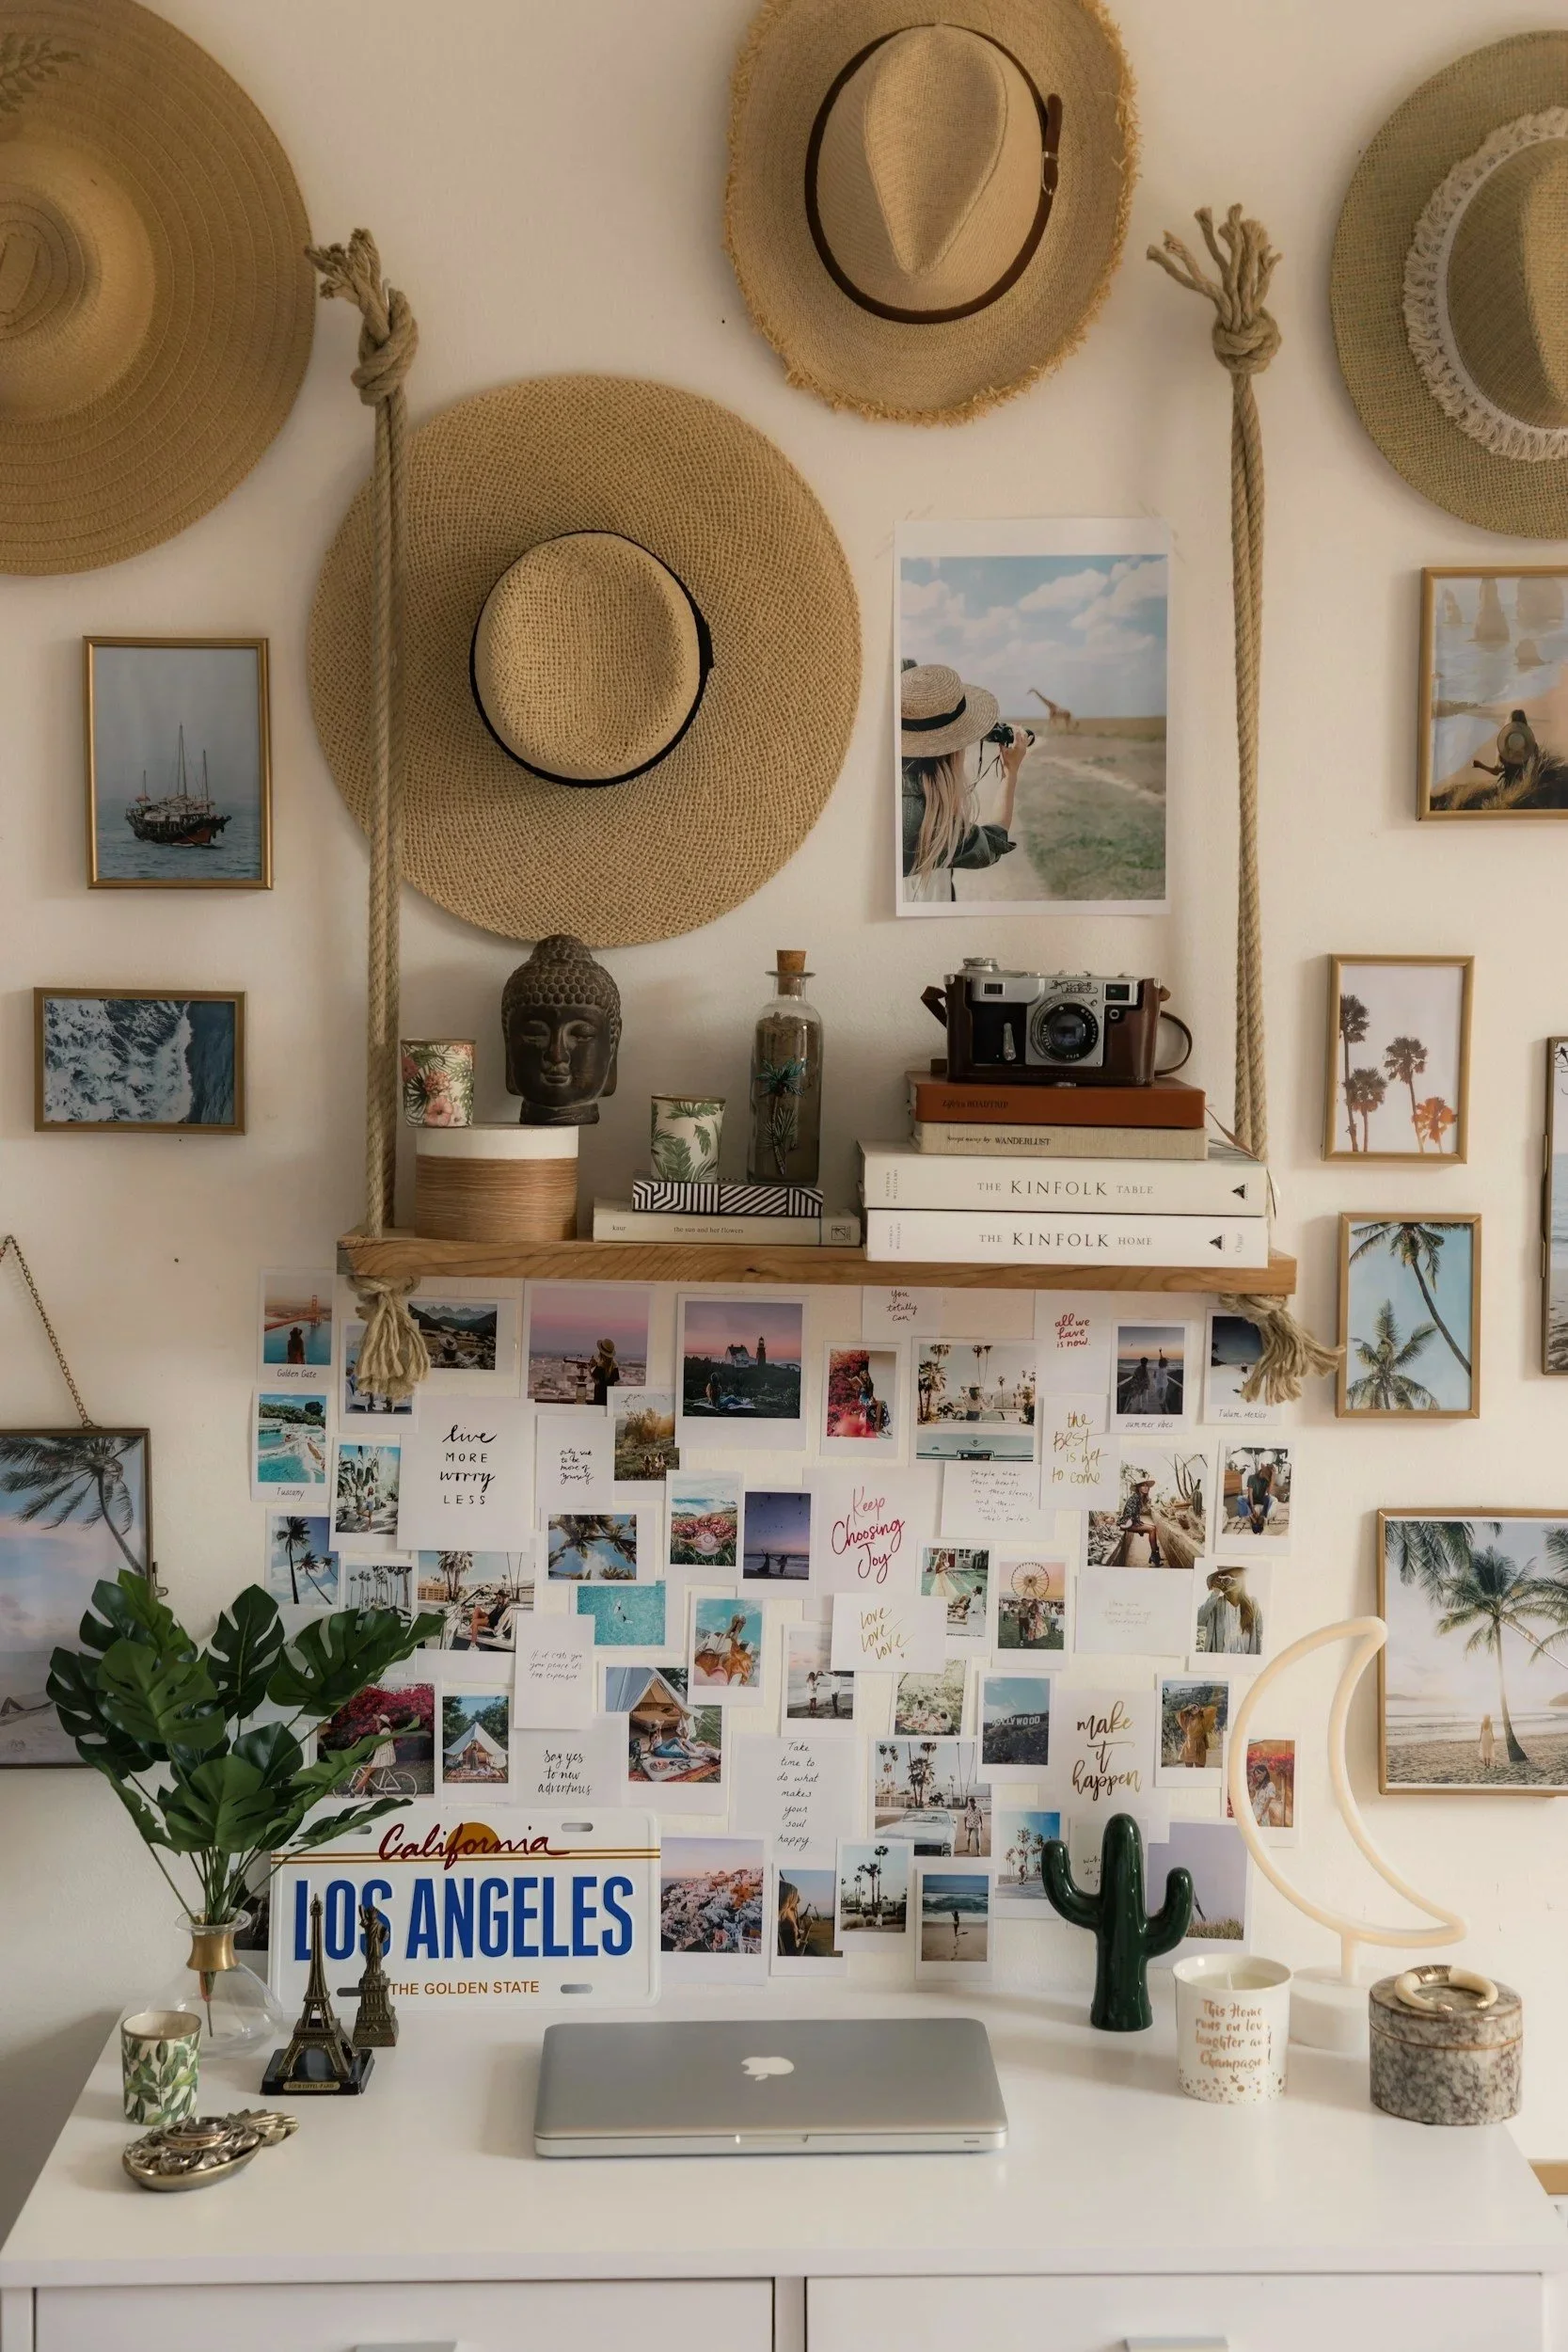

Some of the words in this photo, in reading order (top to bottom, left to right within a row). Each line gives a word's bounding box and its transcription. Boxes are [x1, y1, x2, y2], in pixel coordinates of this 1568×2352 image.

[995, 1136, 1051, 1145] WANDERLUST
[977, 1182, 1002, 1191] THE
[1011, 1181, 1107, 1196] KINFOLK
[1117, 1184, 1153, 1194] TABLE
[979, 1233, 1003, 1243] THE
[1013, 1232, 1109, 1248] KINFOLK
[1118, 1236, 1152, 1246] HOME
[885, 1302, 918, 1315] totally
[1054, 1312, 1074, 1327] all
[1057, 1327, 1085, 1340] have
[1067, 1337, 1091, 1347] now.
[277, 1369, 299, 1377] Golden
[301, 1369, 317, 1378] Gate
[1067, 1411, 1093, 1428] the
[1157, 1420, 1173, 1428] vibes
[442, 1424, 498, 1443] live
[445, 1453, 488, 1463] MORE
[1066, 1450, 1076, 1463] is
[1082, 1448, 1111, 1473] yet
[439, 1470, 496, 1493] worry
[560, 1471, 594, 1485] yourself
[1053, 1466, 1064, 1484] to
[1070, 1470, 1101, 1485] come
[277, 1486, 305, 1502] Tuscany
[443, 1494, 485, 1505] LESS
[852, 1486, 885, 1525] Keep
[832, 1514, 905, 1555] Choosing
[857, 1542, 892, 1584] Joy
[860, 1607, 893, 1629] love
[861, 1618, 903, 1652] love
[875, 1633, 915, 1660] love
[1076, 1700, 1134, 1740] make
[787, 1741, 810, 1752] Take
[543, 1749, 562, 1770] Say
[565, 1753, 586, 1770] yes
[781, 1756, 800, 1767] time
[806, 1756, 816, 1767] to
[1086, 1740, 1135, 1773] it
[543, 1765, 558, 1780] to
[559, 1772, 580, 1780] new
[777, 1772, 788, 1782] do
[794, 1772, 819, 1783] what
[1072, 1759, 1143, 1802] happen
[537, 1782, 593, 1796] adventures
[781, 1787, 812, 1798] makes
[782, 1805, 808, 1820] your
[784, 1819, 807, 1828] soul
[378, 1822, 570, 1871] California
[777, 1833, 813, 1852] happy.
[294, 1880, 393, 1962] LOS
[405, 1876, 634, 1960] ANGELES
[389, 1982, 420, 1995] THE
[424, 1981, 488, 1995] GOLDEN
[493, 1980, 540, 1994] STATE
[1202, 1998, 1226, 2019] This
[1228, 2002, 1263, 2019] Home
[1196, 2018, 1221, 2032] runs
[1227, 2023, 1241, 2032] on
[1196, 2029, 1245, 2052] laughter
